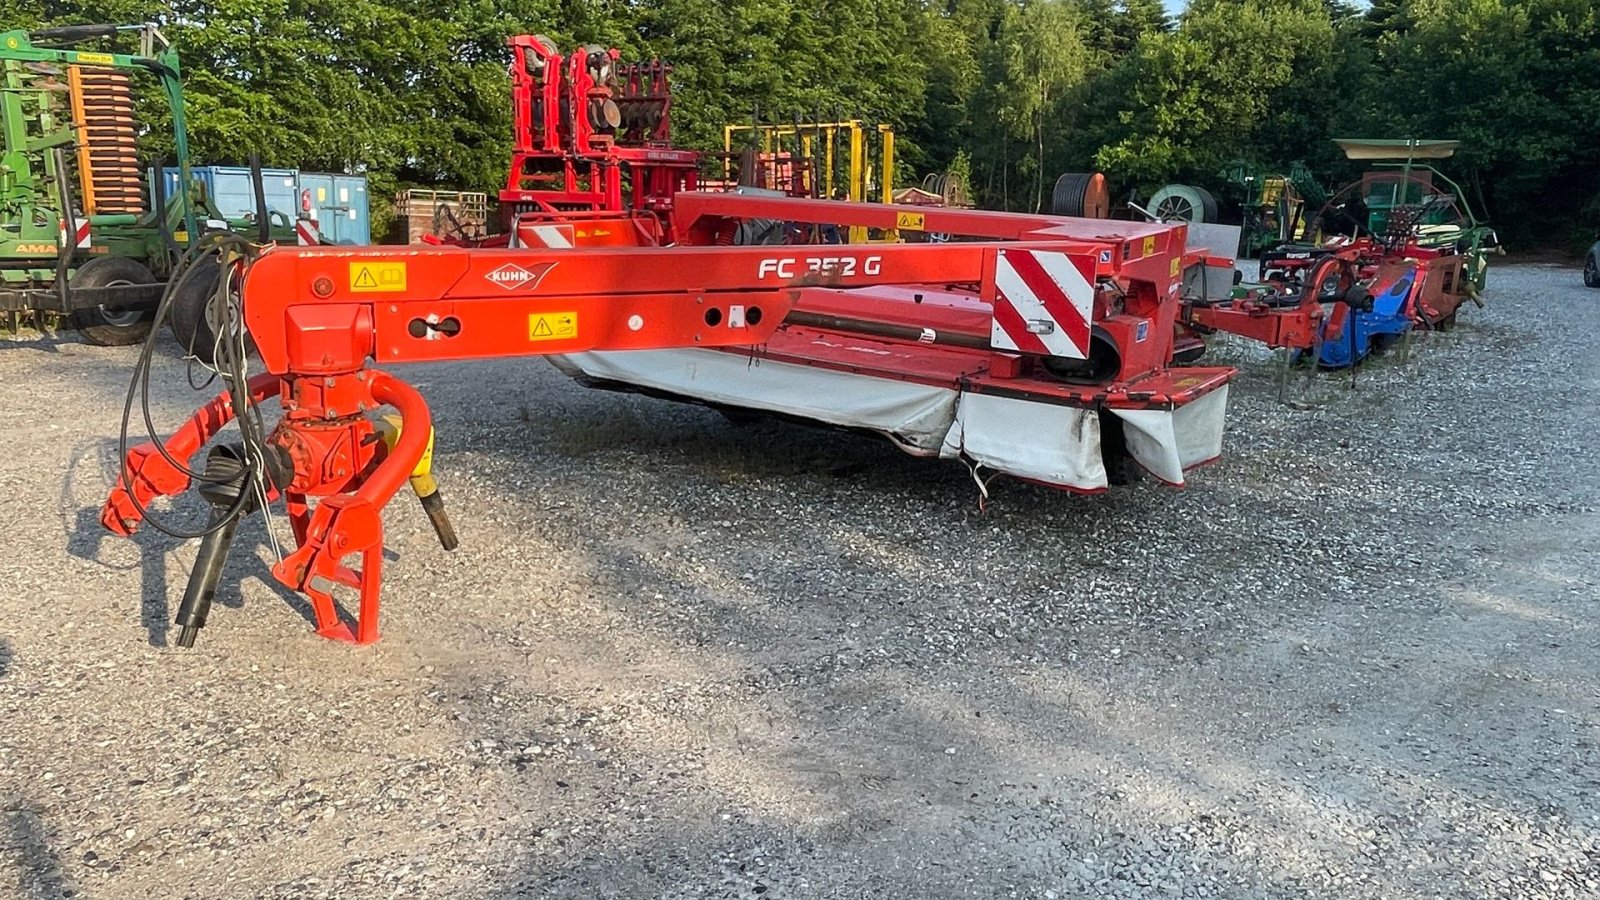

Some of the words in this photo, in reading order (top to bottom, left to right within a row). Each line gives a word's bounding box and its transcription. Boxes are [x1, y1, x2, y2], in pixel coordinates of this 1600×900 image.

[758, 258, 796, 279] FC
[804, 257, 857, 277] 352
[864, 256, 882, 275] G
[492, 271, 529, 281] KUHN
